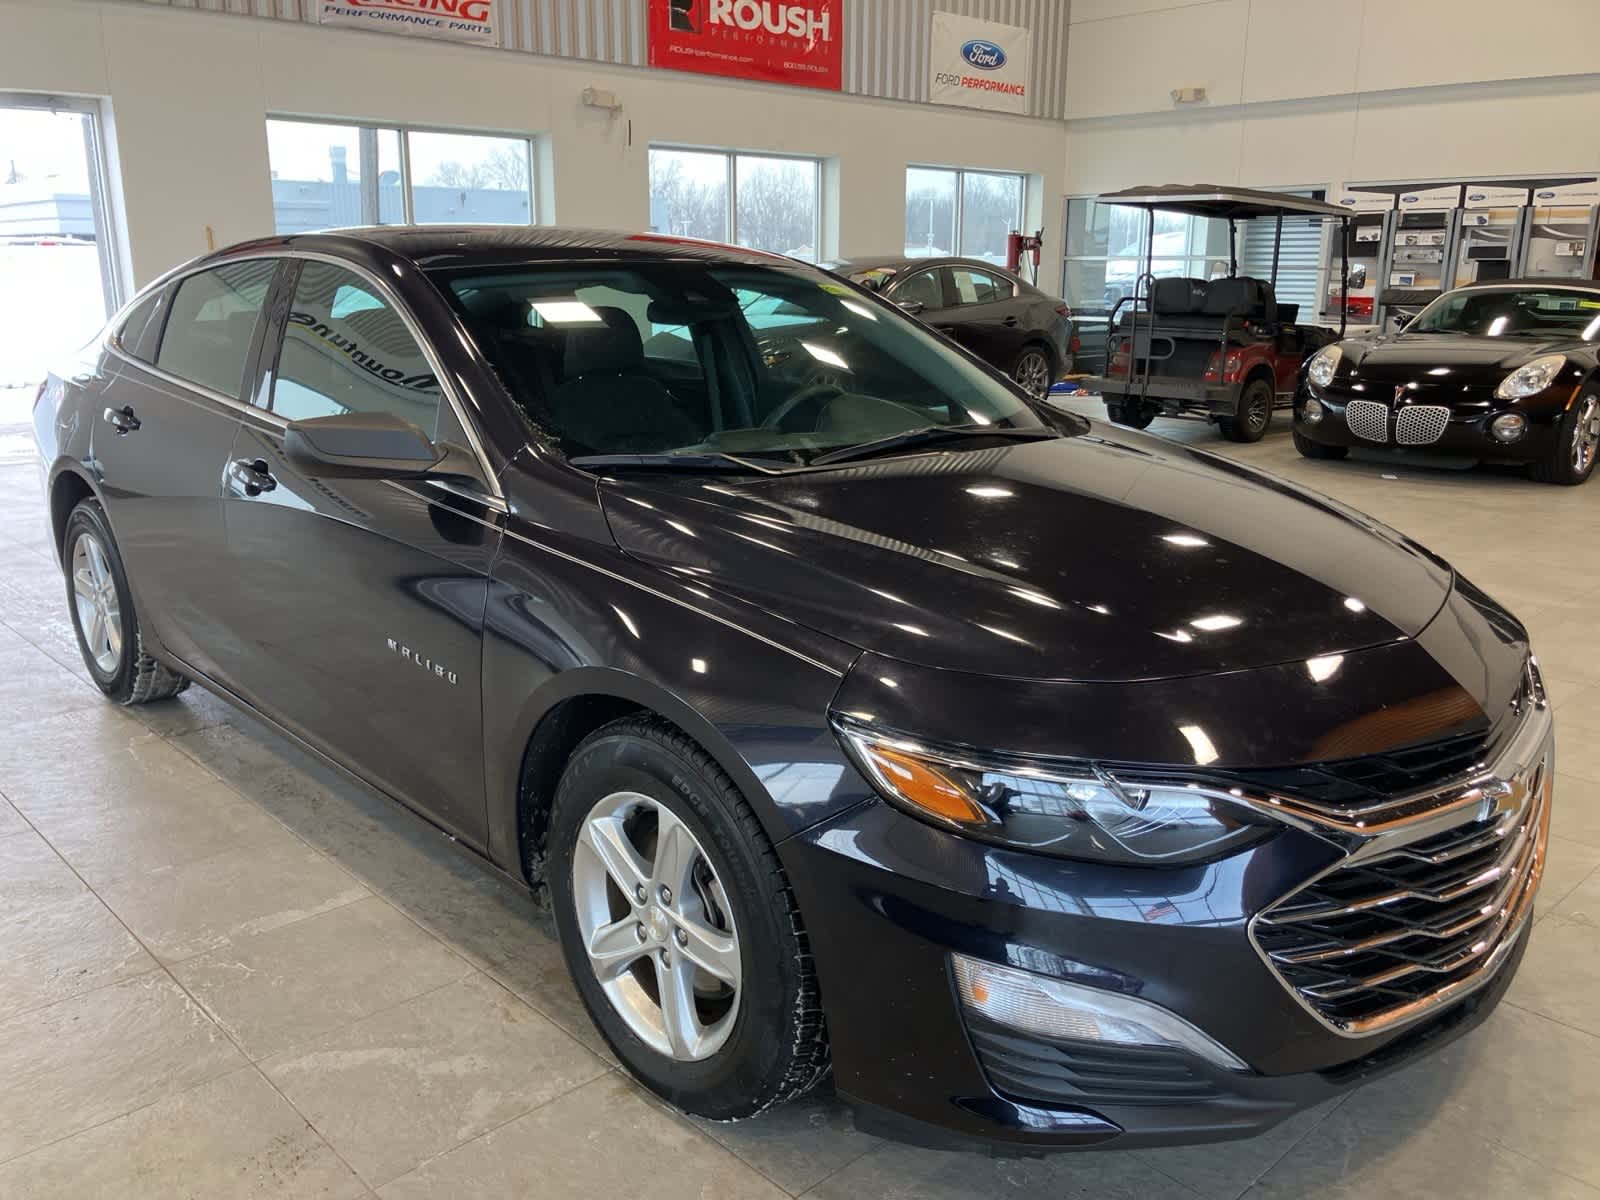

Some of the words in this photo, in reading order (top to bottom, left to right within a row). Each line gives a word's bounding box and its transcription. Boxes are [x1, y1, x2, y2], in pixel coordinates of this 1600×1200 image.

[324, 5, 445, 27] PERFORMANCE
[448, 22, 492, 34] PARTS
[326, 0, 491, 22] ING
[709, 0, 832, 42] ROUSH
[968, 43, 997, 66] Ford
[935, 72, 960, 86] FORD
[961, 76, 1025, 96] PERFORMANCE
[387, 638, 457, 685] MALIBU
